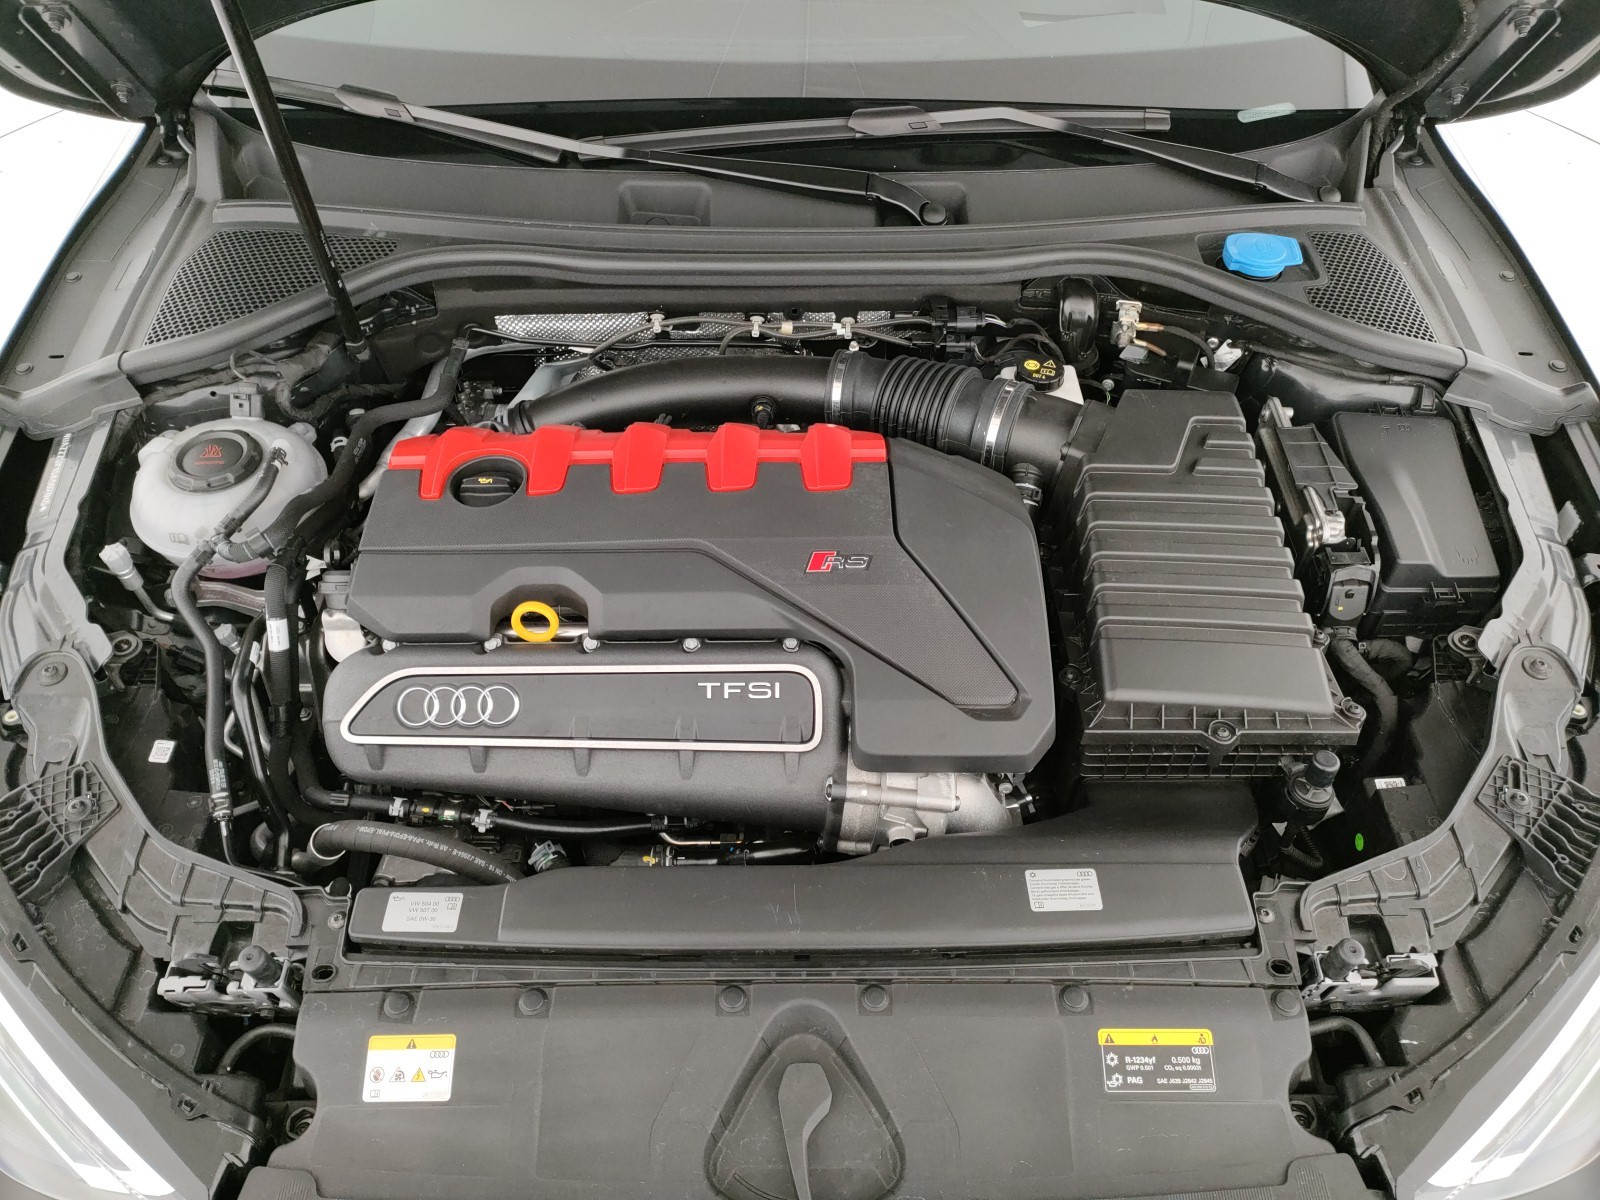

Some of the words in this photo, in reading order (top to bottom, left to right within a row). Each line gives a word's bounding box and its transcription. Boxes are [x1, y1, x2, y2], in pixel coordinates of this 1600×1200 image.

[697, 682, 780, 699] TFSI
[474, 856, 486, 867] SAE
[1125, 1056, 1156, 1065] R-1234yf
[1171, 1056, 1191, 1064] 0.500
[1191, 1056, 1201, 1065] kg
[1127, 1076, 1143, 1084] PAG
